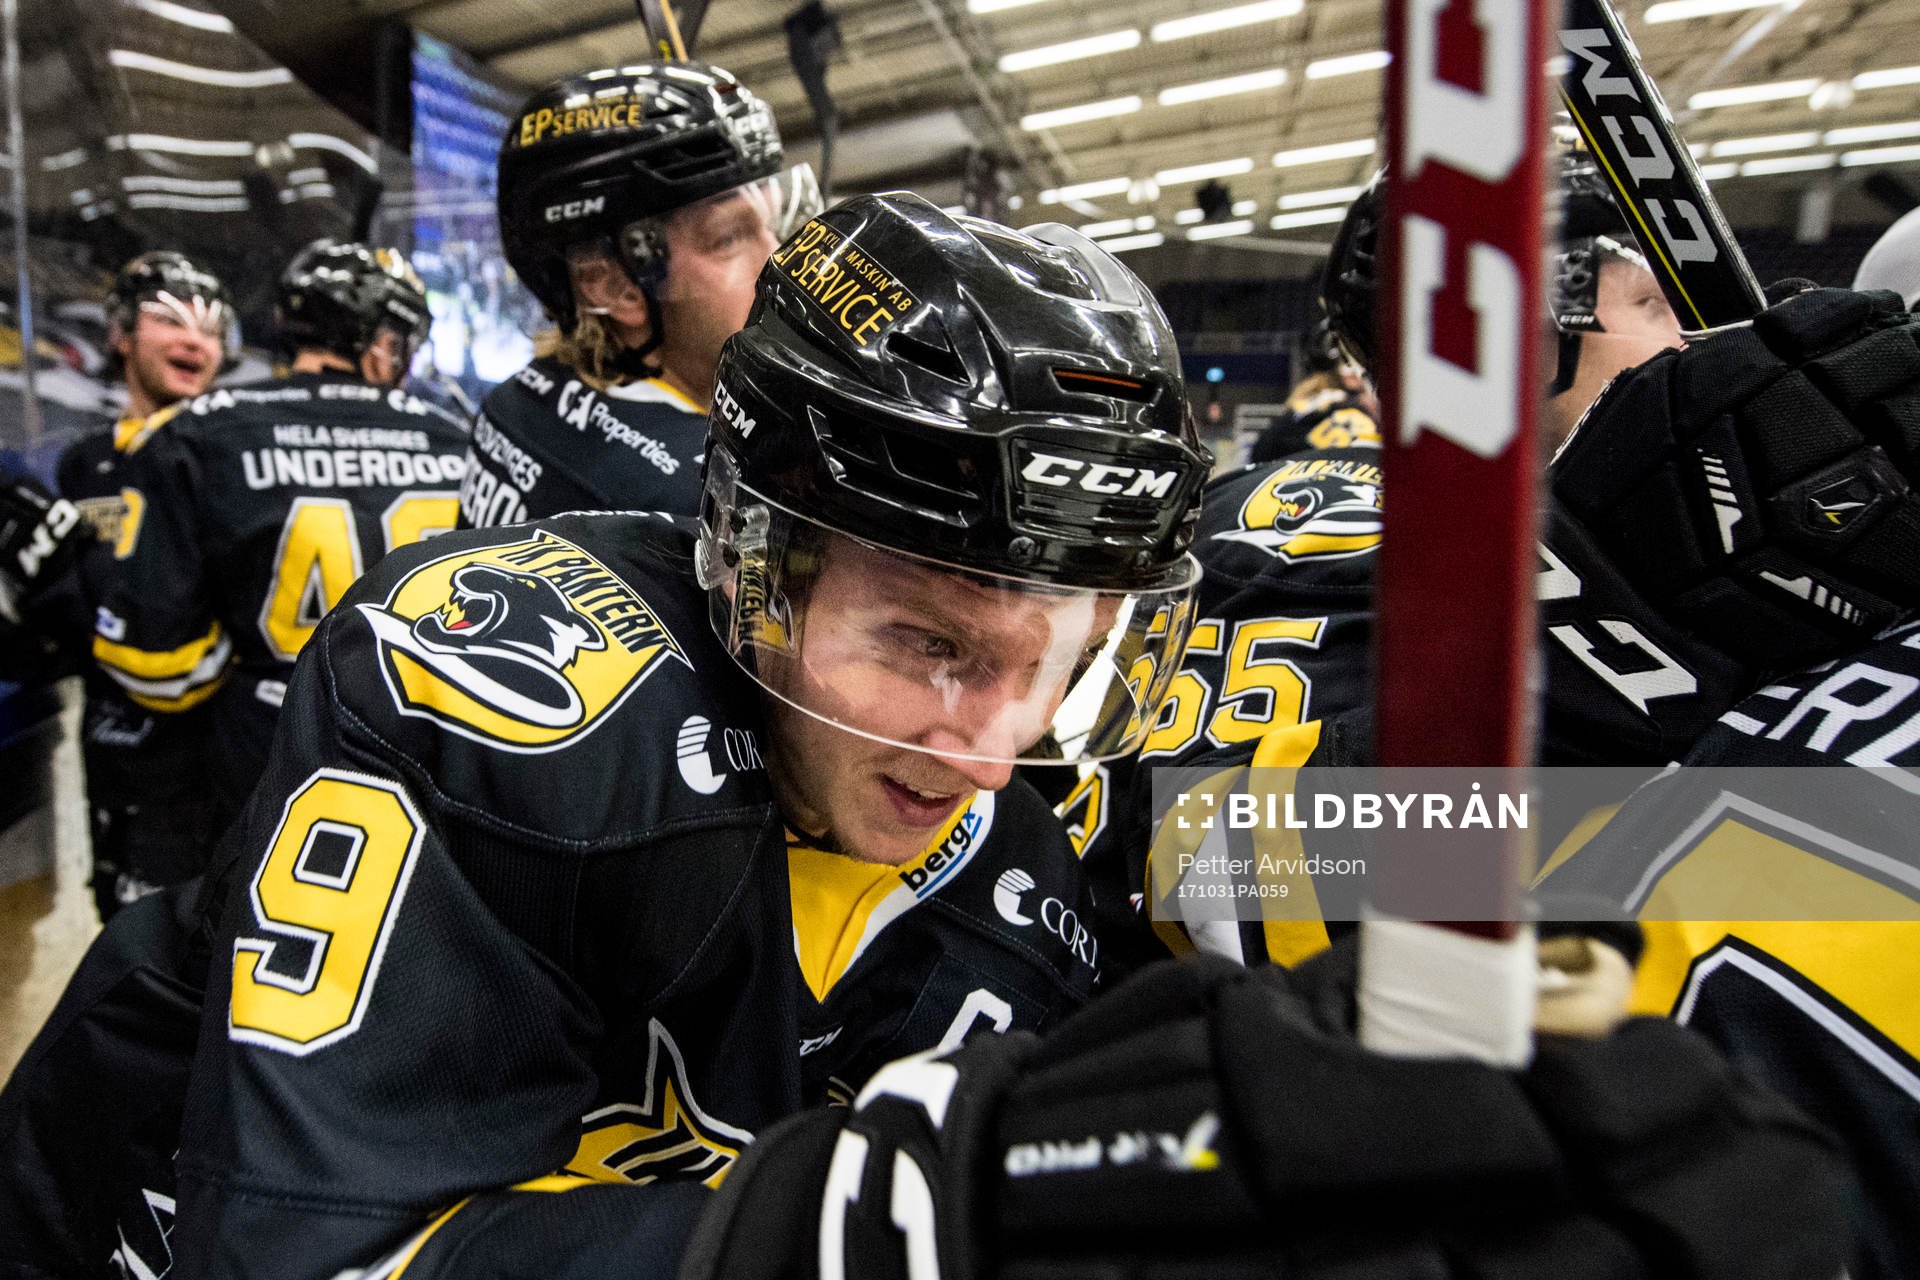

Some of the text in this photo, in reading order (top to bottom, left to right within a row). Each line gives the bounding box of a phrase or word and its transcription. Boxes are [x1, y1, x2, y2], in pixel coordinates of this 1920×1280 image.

[1557, 28, 1718, 271] CCM
[544, 196, 605, 222] CCM
[823, 231, 841, 249] KYL
[845, 250, 892, 292] MASKIN
[888, 291, 913, 312] AB
[589, 402, 682, 477] Properties
[715, 379, 757, 439] CCM
[1021, 452, 1178, 499] CCM
[525, 556, 670, 654] PANTERN
[228, 767, 427, 1056] 9
